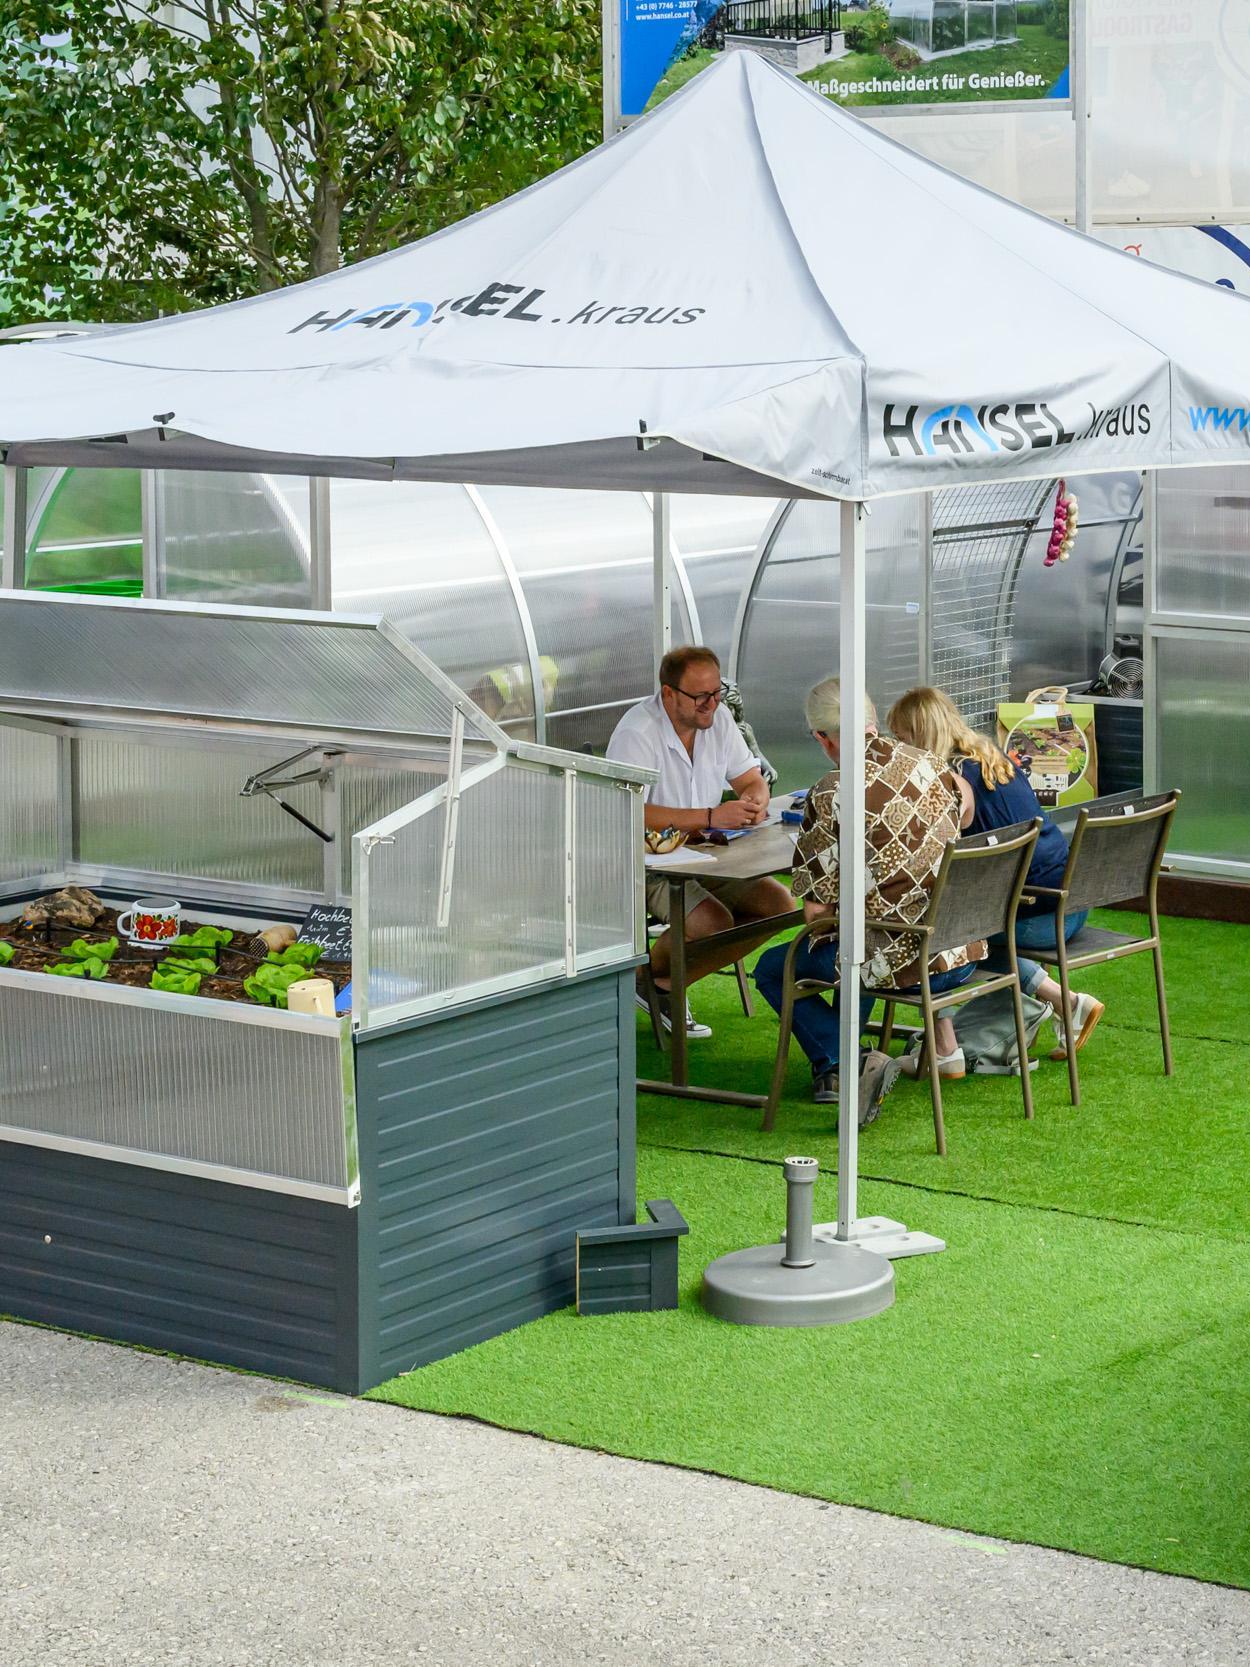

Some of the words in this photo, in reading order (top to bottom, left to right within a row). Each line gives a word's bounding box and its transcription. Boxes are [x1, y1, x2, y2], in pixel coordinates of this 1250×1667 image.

[807, 74, 939, 98] Maßgeschneidert
[942, 73, 965, 90] für
[968, 71, 1046, 90] Genießer.
